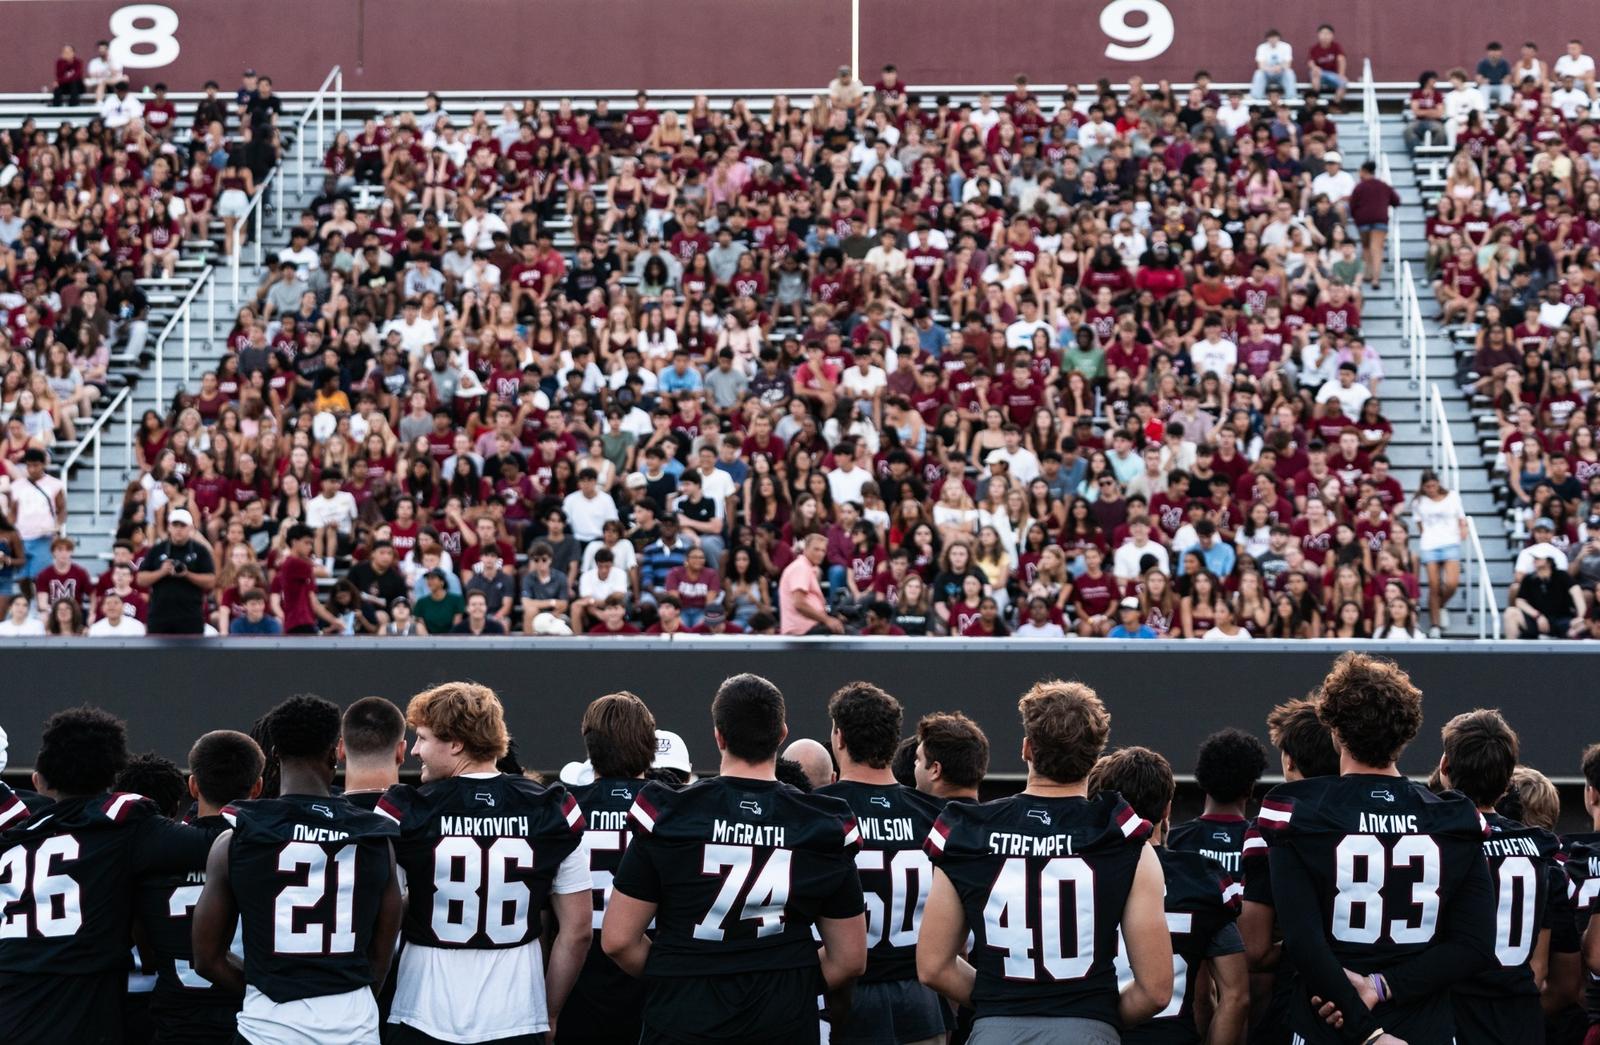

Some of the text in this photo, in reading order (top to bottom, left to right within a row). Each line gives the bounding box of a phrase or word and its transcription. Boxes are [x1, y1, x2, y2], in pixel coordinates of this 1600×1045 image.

[109, 4, 180, 69] 8
[1099, 0, 1174, 61] 9
[497, 378, 520, 399] M
[440, 531, 461, 553] M
[852, 557, 875, 577] M
[50, 578, 76, 603] M
[440, 815, 529, 836] MARKOVICH
[590, 810, 628, 830] COOP
[712, 819, 785, 847] McGRATH
[858, 816, 914, 841] WILSON
[1359, 811, 1418, 833] ADKINS
[988, 832, 1079, 856] STREMPEL
[1482, 837, 1540, 857] TCHEON
[0, 834, 82, 939] 26
[274, 841, 358, 954] 21
[431, 837, 534, 944] 86
[693, 843, 793, 941] 74
[853, 849, 933, 949] 50
[1332, 834, 1441, 944] 83
[983, 857, 1095, 980] 40
[1495, 856, 1537, 966] 0
